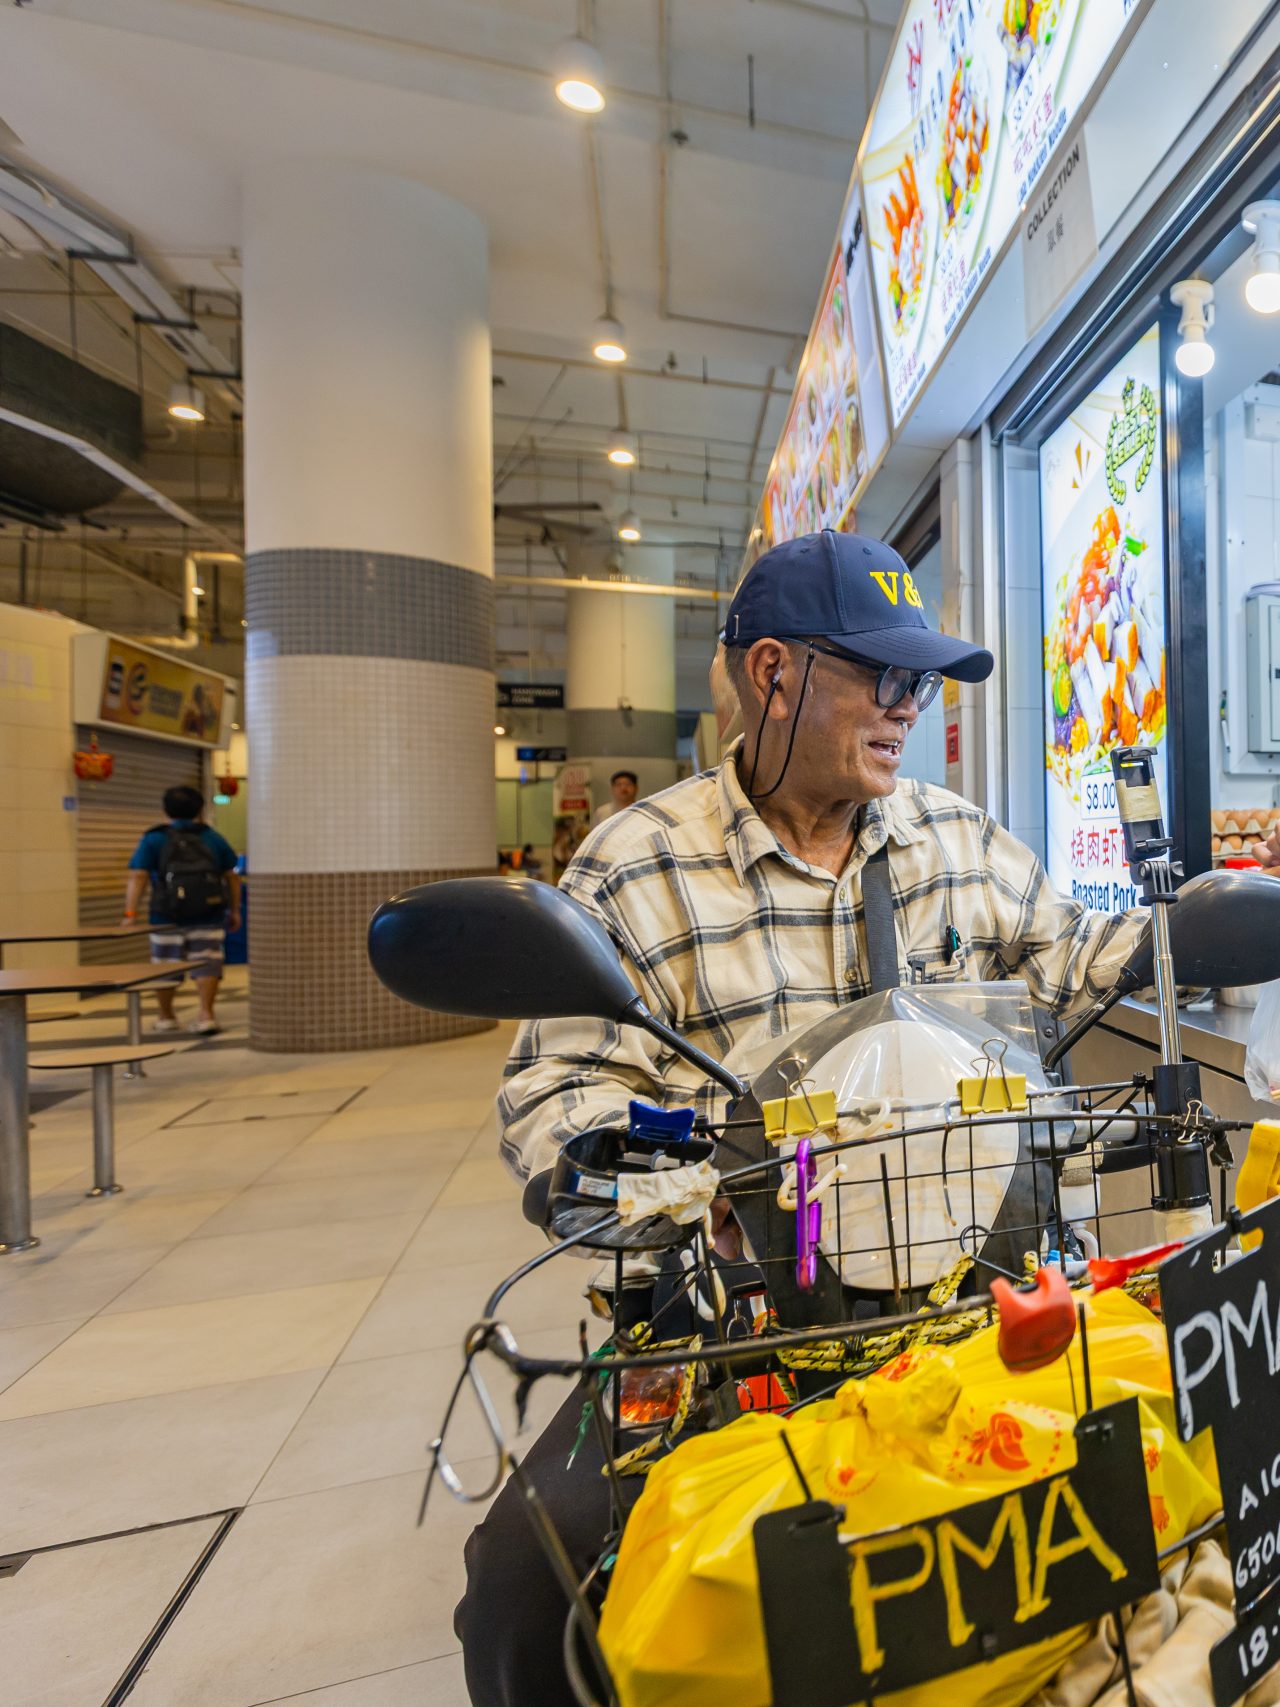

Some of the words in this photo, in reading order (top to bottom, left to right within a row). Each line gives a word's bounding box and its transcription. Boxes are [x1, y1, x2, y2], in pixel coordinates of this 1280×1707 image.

[1027, 144, 1080, 240] COLLECTION
[1112, 422, 1149, 471] SELLER
[1117, 404, 1141, 445] BEST
[1086, 783, 1116, 811] $8.00
[1113, 882, 1136, 913] Pork
[846, 1474, 1128, 1673] PMA
